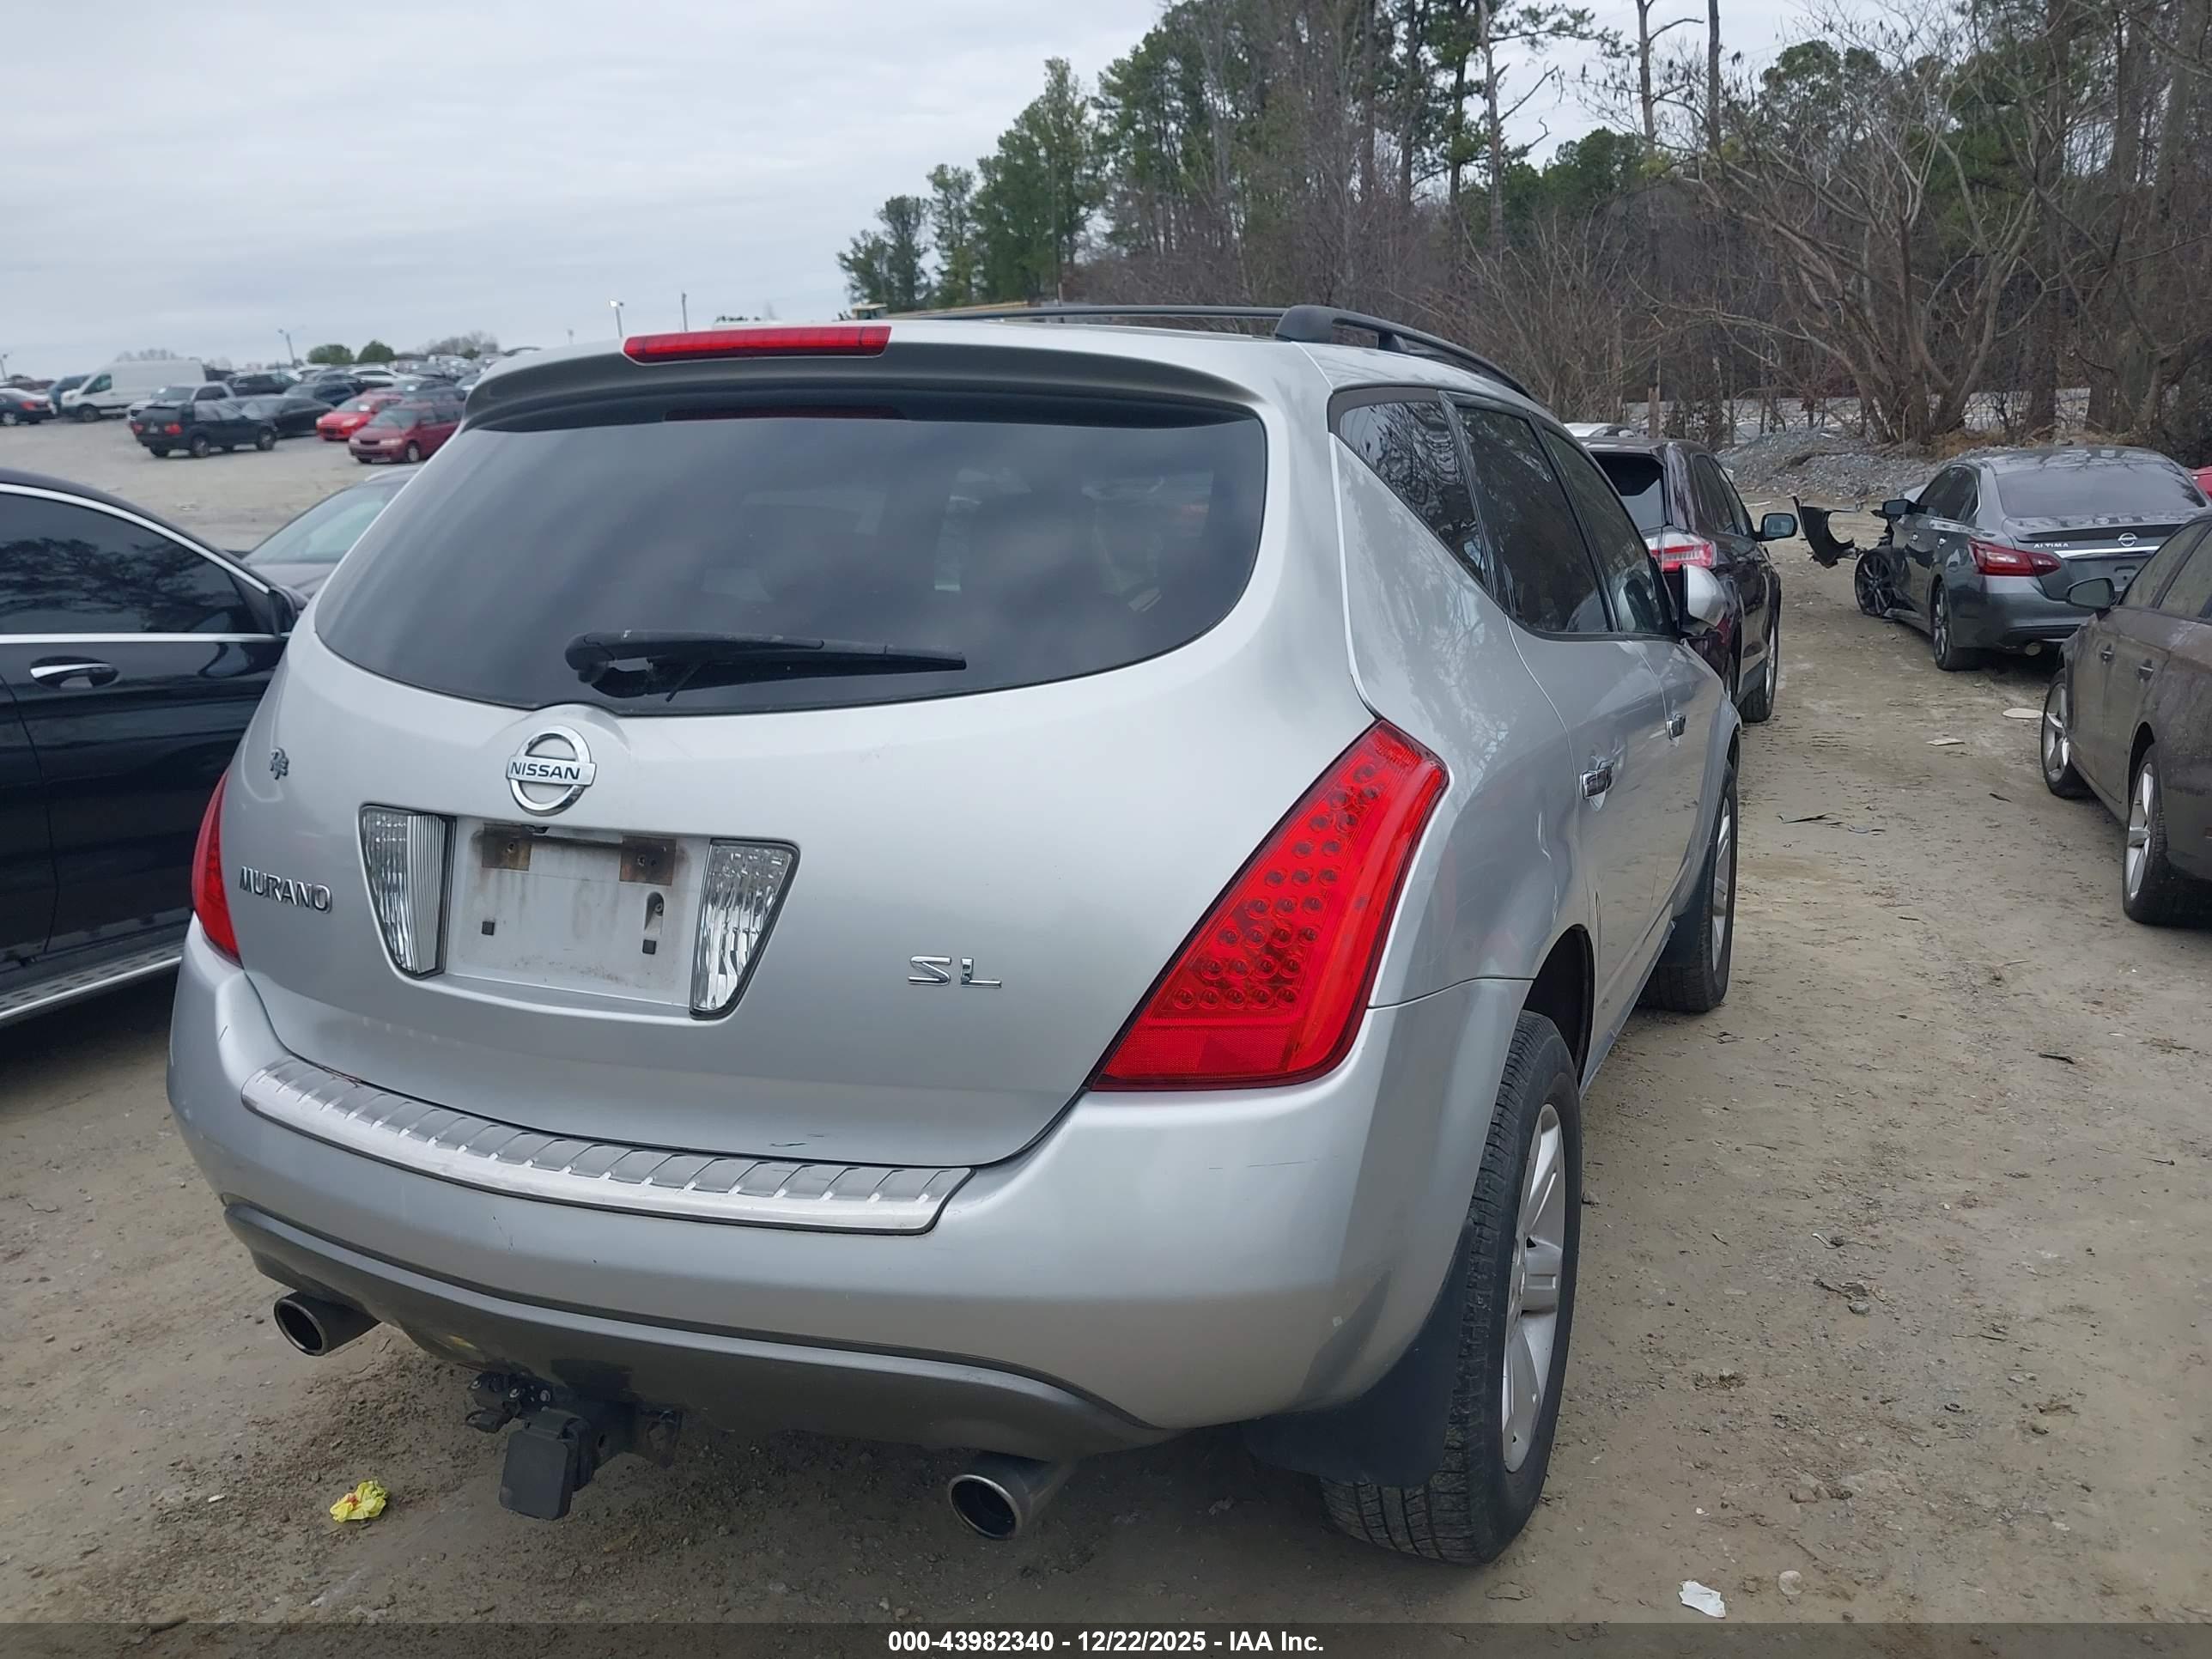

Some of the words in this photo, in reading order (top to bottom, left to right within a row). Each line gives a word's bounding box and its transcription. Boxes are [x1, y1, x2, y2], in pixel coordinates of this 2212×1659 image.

[511, 762, 581, 780] NISSAN
[240, 866, 332, 913] MURANO
[908, 956, 1002, 988] SL
